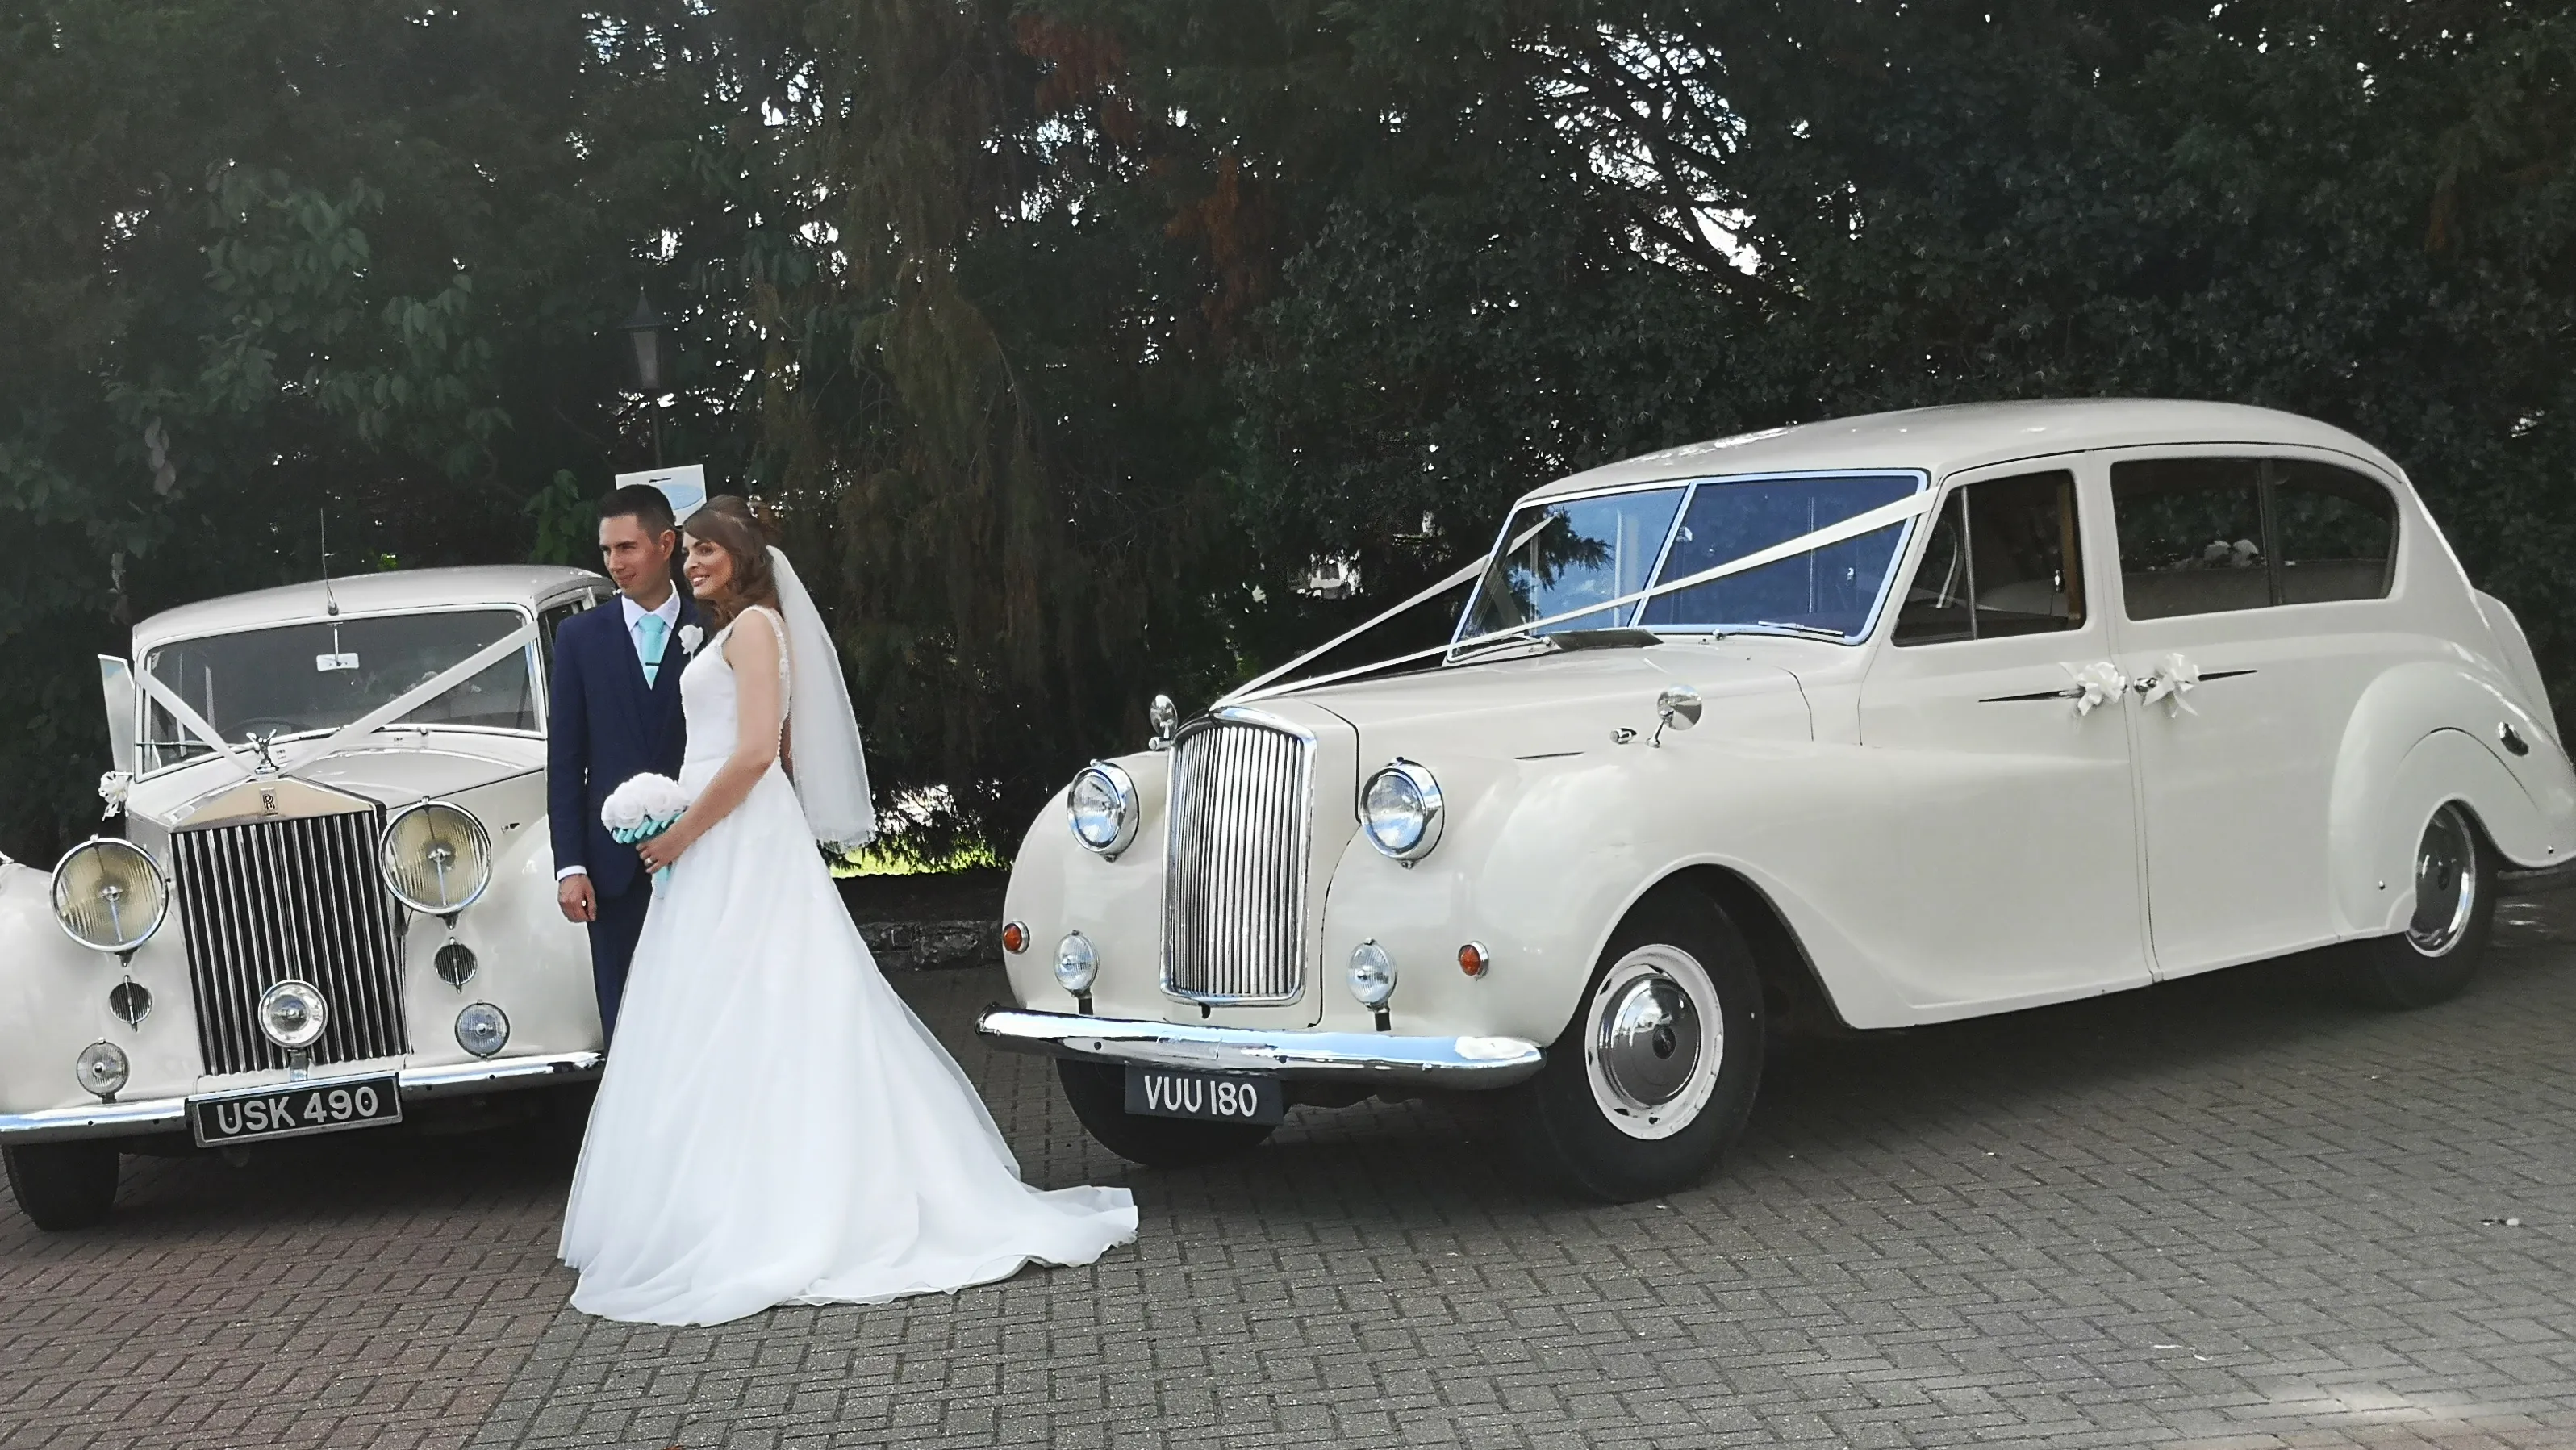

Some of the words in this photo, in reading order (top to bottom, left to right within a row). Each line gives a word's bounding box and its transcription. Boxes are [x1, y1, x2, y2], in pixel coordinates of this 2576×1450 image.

[217, 1096, 295, 1135] USK
[303, 1086, 378, 1123] 490
[1144, 1075, 1203, 1113] VUU
[1210, 1080, 1257, 1117] 180
